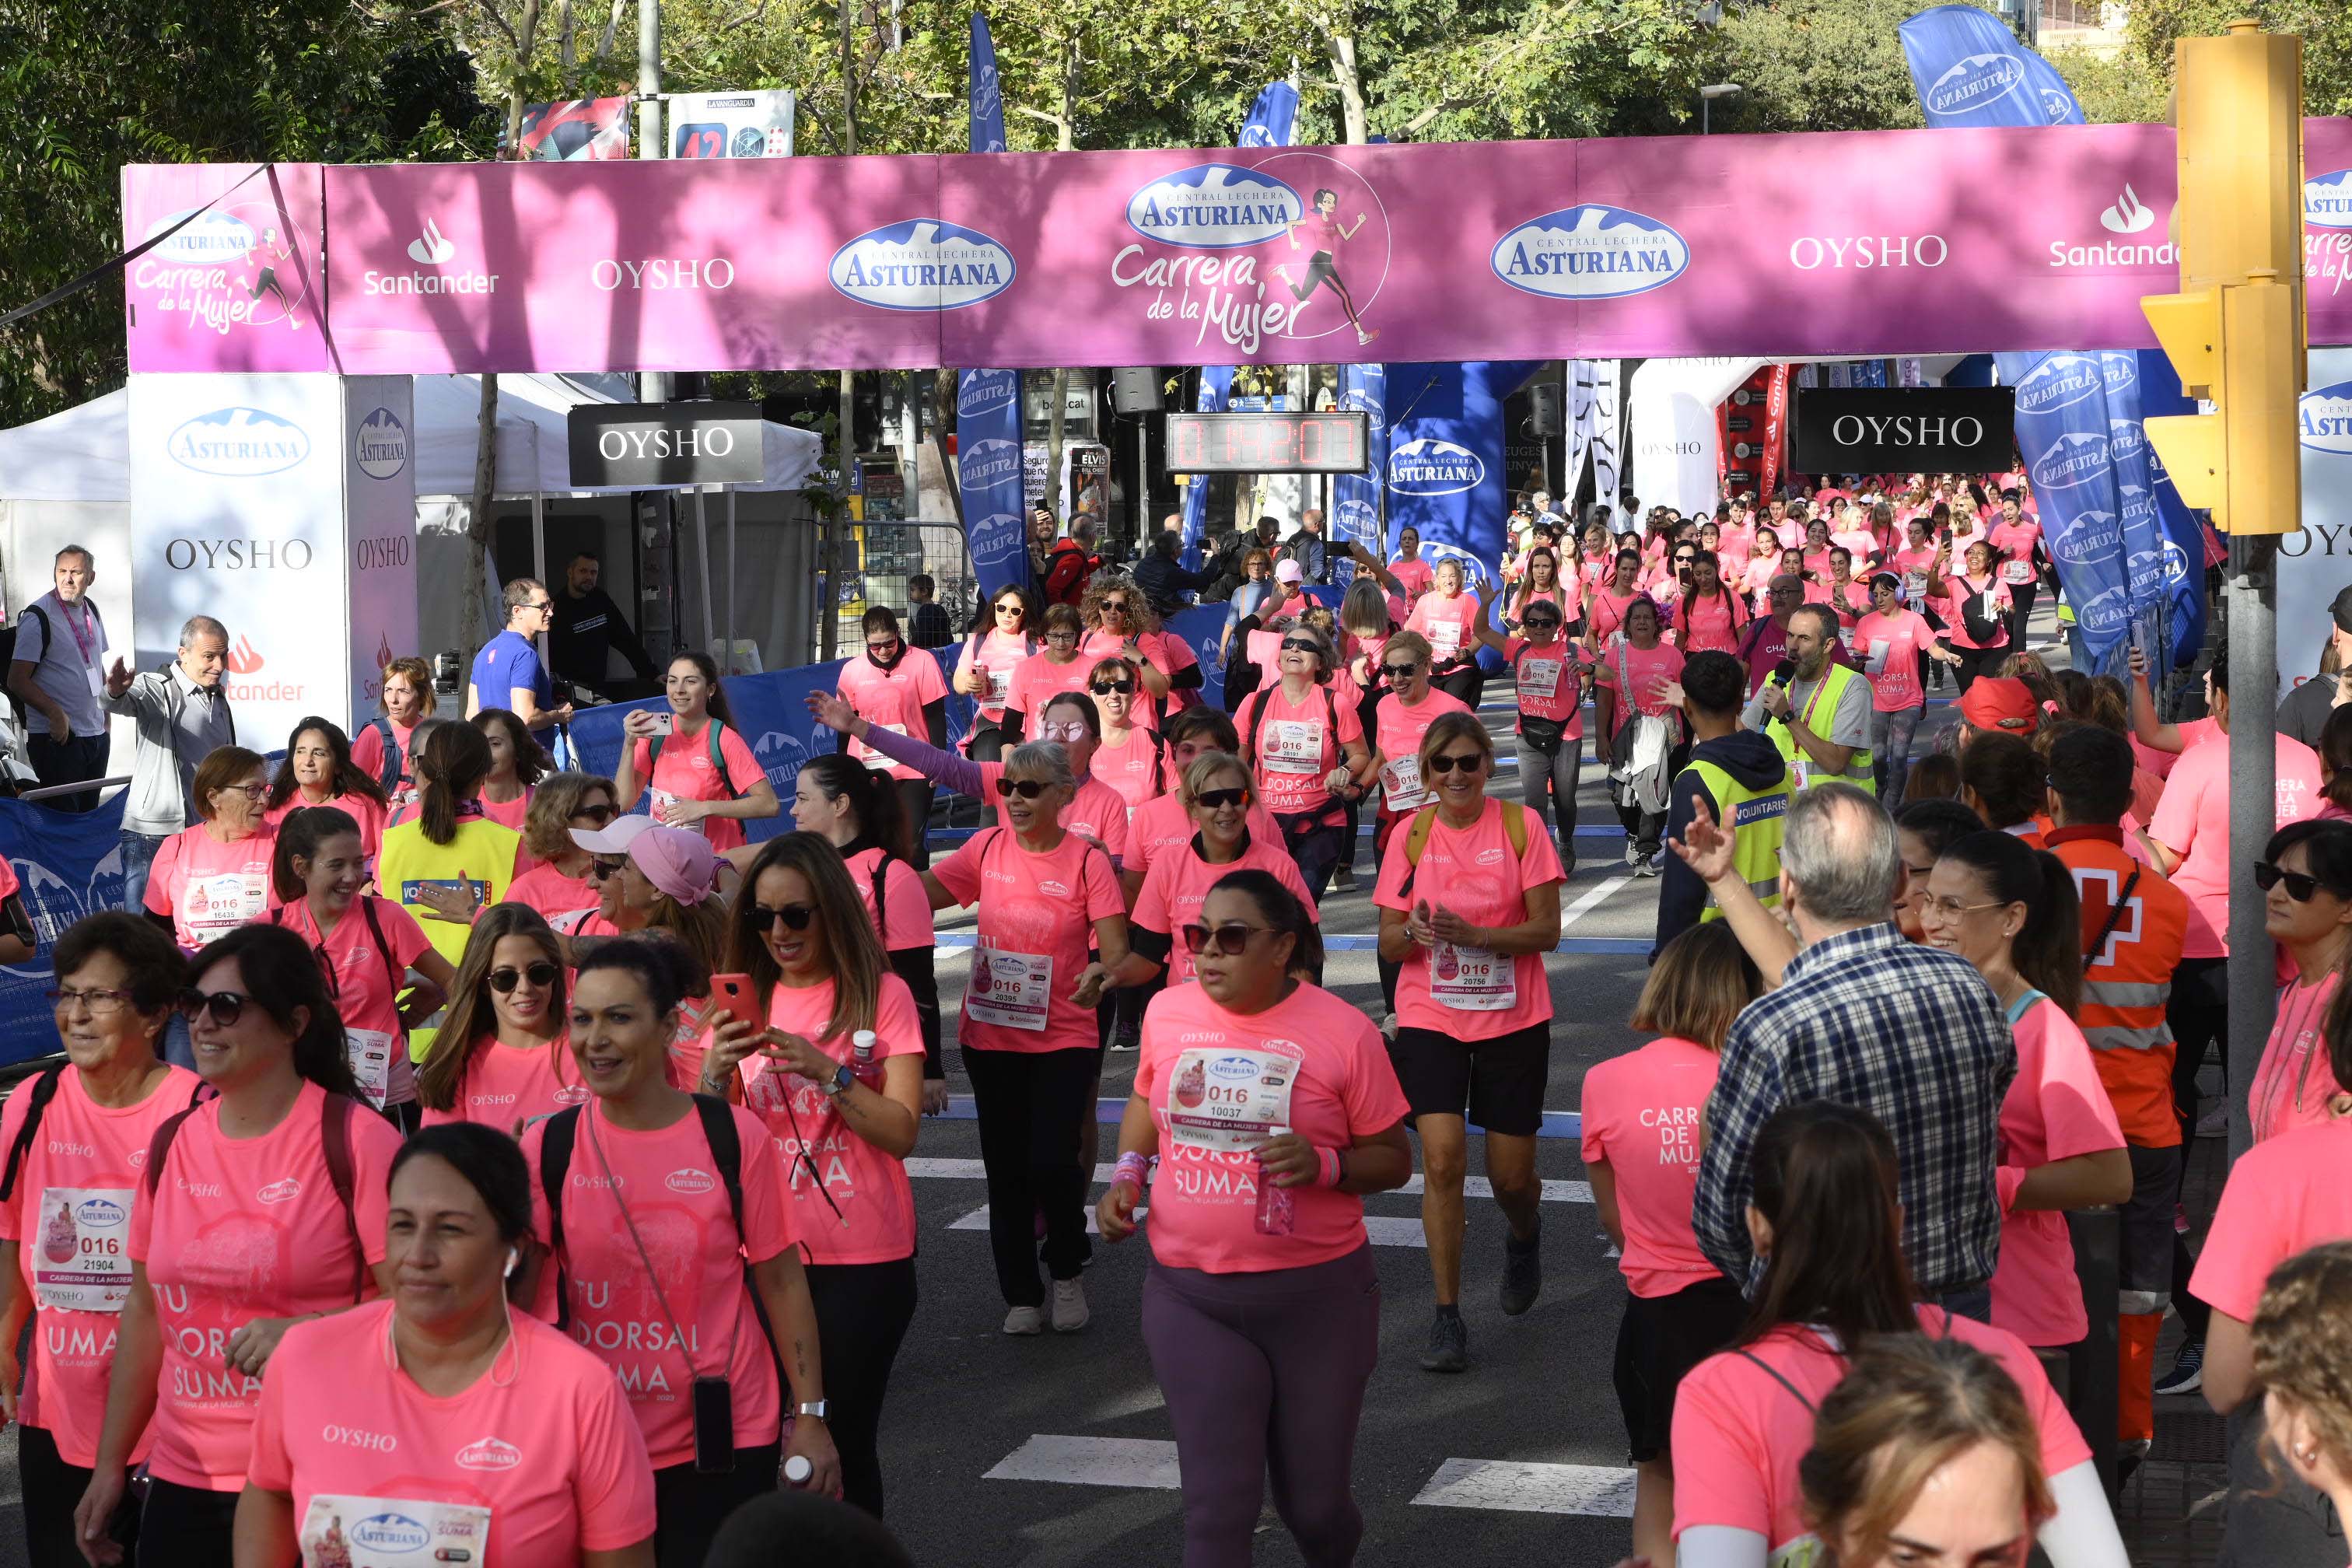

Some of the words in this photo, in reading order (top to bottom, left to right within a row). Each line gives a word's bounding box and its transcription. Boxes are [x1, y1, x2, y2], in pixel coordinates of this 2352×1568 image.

[1167, 192, 1223, 201] CENTRAL
[1228, 191, 1285, 200] LECHERA
[1140, 195, 1289, 227] ASTURIANA
[1537, 238, 1598, 247] CENTRAL
[1605, 236, 1667, 246] LECHERA
[872, 250, 930, 259] CENTRAL
[936, 250, 996, 259] LECHERA
[1507, 241, 1674, 275] ASTURIANA
[1790, 235, 1948, 270] OYSHO
[843, 254, 1001, 287] ASTURIANA
[1111, 244, 1257, 287] Carrera
[2322, 257, 2336, 278] la
[135, 261, 226, 289] Carrera
[591, 258, 735, 291] OYSHO
[363, 271, 499, 295] Santander
[158, 290, 174, 310] de
[179, 290, 191, 310] la
[189, 286, 261, 334] Mujer
[1147, 290, 1174, 319] de
[1180, 288, 1199, 319] la
[1195, 282, 1311, 355] Mujer
[1832, 415, 1983, 446] OYSHO
[179, 433, 299, 459] ASTURIANA
[359, 435, 404, 462] ASTURIANA
[599, 427, 733, 460] OYSHO
[1179, 420, 1354, 464] 01:42:07
[1642, 441, 1701, 455] OYSHO
[1082, 455, 1105, 464] ELVIS
[1390, 463, 1477, 484] ASTURIANA
[2278, 524, 2352, 557] OY
[166, 539, 312, 569] OYSHO
[357, 535, 409, 569] OYSHO
[1766, 644, 1785, 653] CHA
[1878, 684, 1904, 693] SUMA
[1521, 696, 1558, 709] DORSAL
[1283, 741, 1302, 750] 016
[1401, 775, 1419, 785] 016
[1264, 792, 1305, 806] SUMA
[2278, 793, 2294, 803] LA
[1736, 800, 1787, 821] VOLUNTARIS
[1155, 837, 1187, 846] OYSHO
[1423, 854, 1451, 863] OYSHO
[985, 870, 1015, 884] OYSHO
[212, 899, 237, 909] 016
[996, 962, 1024, 972] ASTURIANA
[1461, 964, 1489, 975] 016
[994, 980, 1020, 992] 016
[996, 993, 1017, 1002] 20395
[972, 1009, 995, 1019] OYSHO
[1181, 1032, 1225, 1043] OYSHO
[1212, 1063, 1255, 1075] ASTURIANA
[1264, 1063, 1288, 1074] SUMA
[471, 1094, 516, 1106] OYSHO
[1209, 1086, 1248, 1103] 016
[1211, 1106, 1241, 1118] 10037
[1640, 1107, 1699, 1127] CARR
[1181, 1118, 1211, 1128] CARRERA
[1181, 1129, 1213, 1141] OYSHO
[1661, 1126, 1689, 1146] DE
[48, 1140, 94, 1157] OYSHO
[791, 1156, 852, 1190] MA
[573, 1174, 624, 1189] OYSHO
[670, 1178, 711, 1188] ASTURIANA
[1175, 1169, 1257, 1195] SUMA
[79, 1207, 121, 1220] ASTURIANA
[81, 1237, 120, 1254] 016
[84, 1260, 114, 1271] 21904
[48, 1290, 84, 1301] OYSHO
[152, 1283, 187, 1313] TU
[575, 1279, 609, 1309] TU
[47, 1326, 117, 1356] UMA
[174, 1366, 262, 1398] SUMA
[616, 1363, 670, 1392] MA
[323, 1424, 397, 1453] OYSHO
[462, 1451, 516, 1464] ASTURIANA
[359, 1526, 423, 1545] ASTURIANA
[437, 1527, 474, 1537] SUMA
